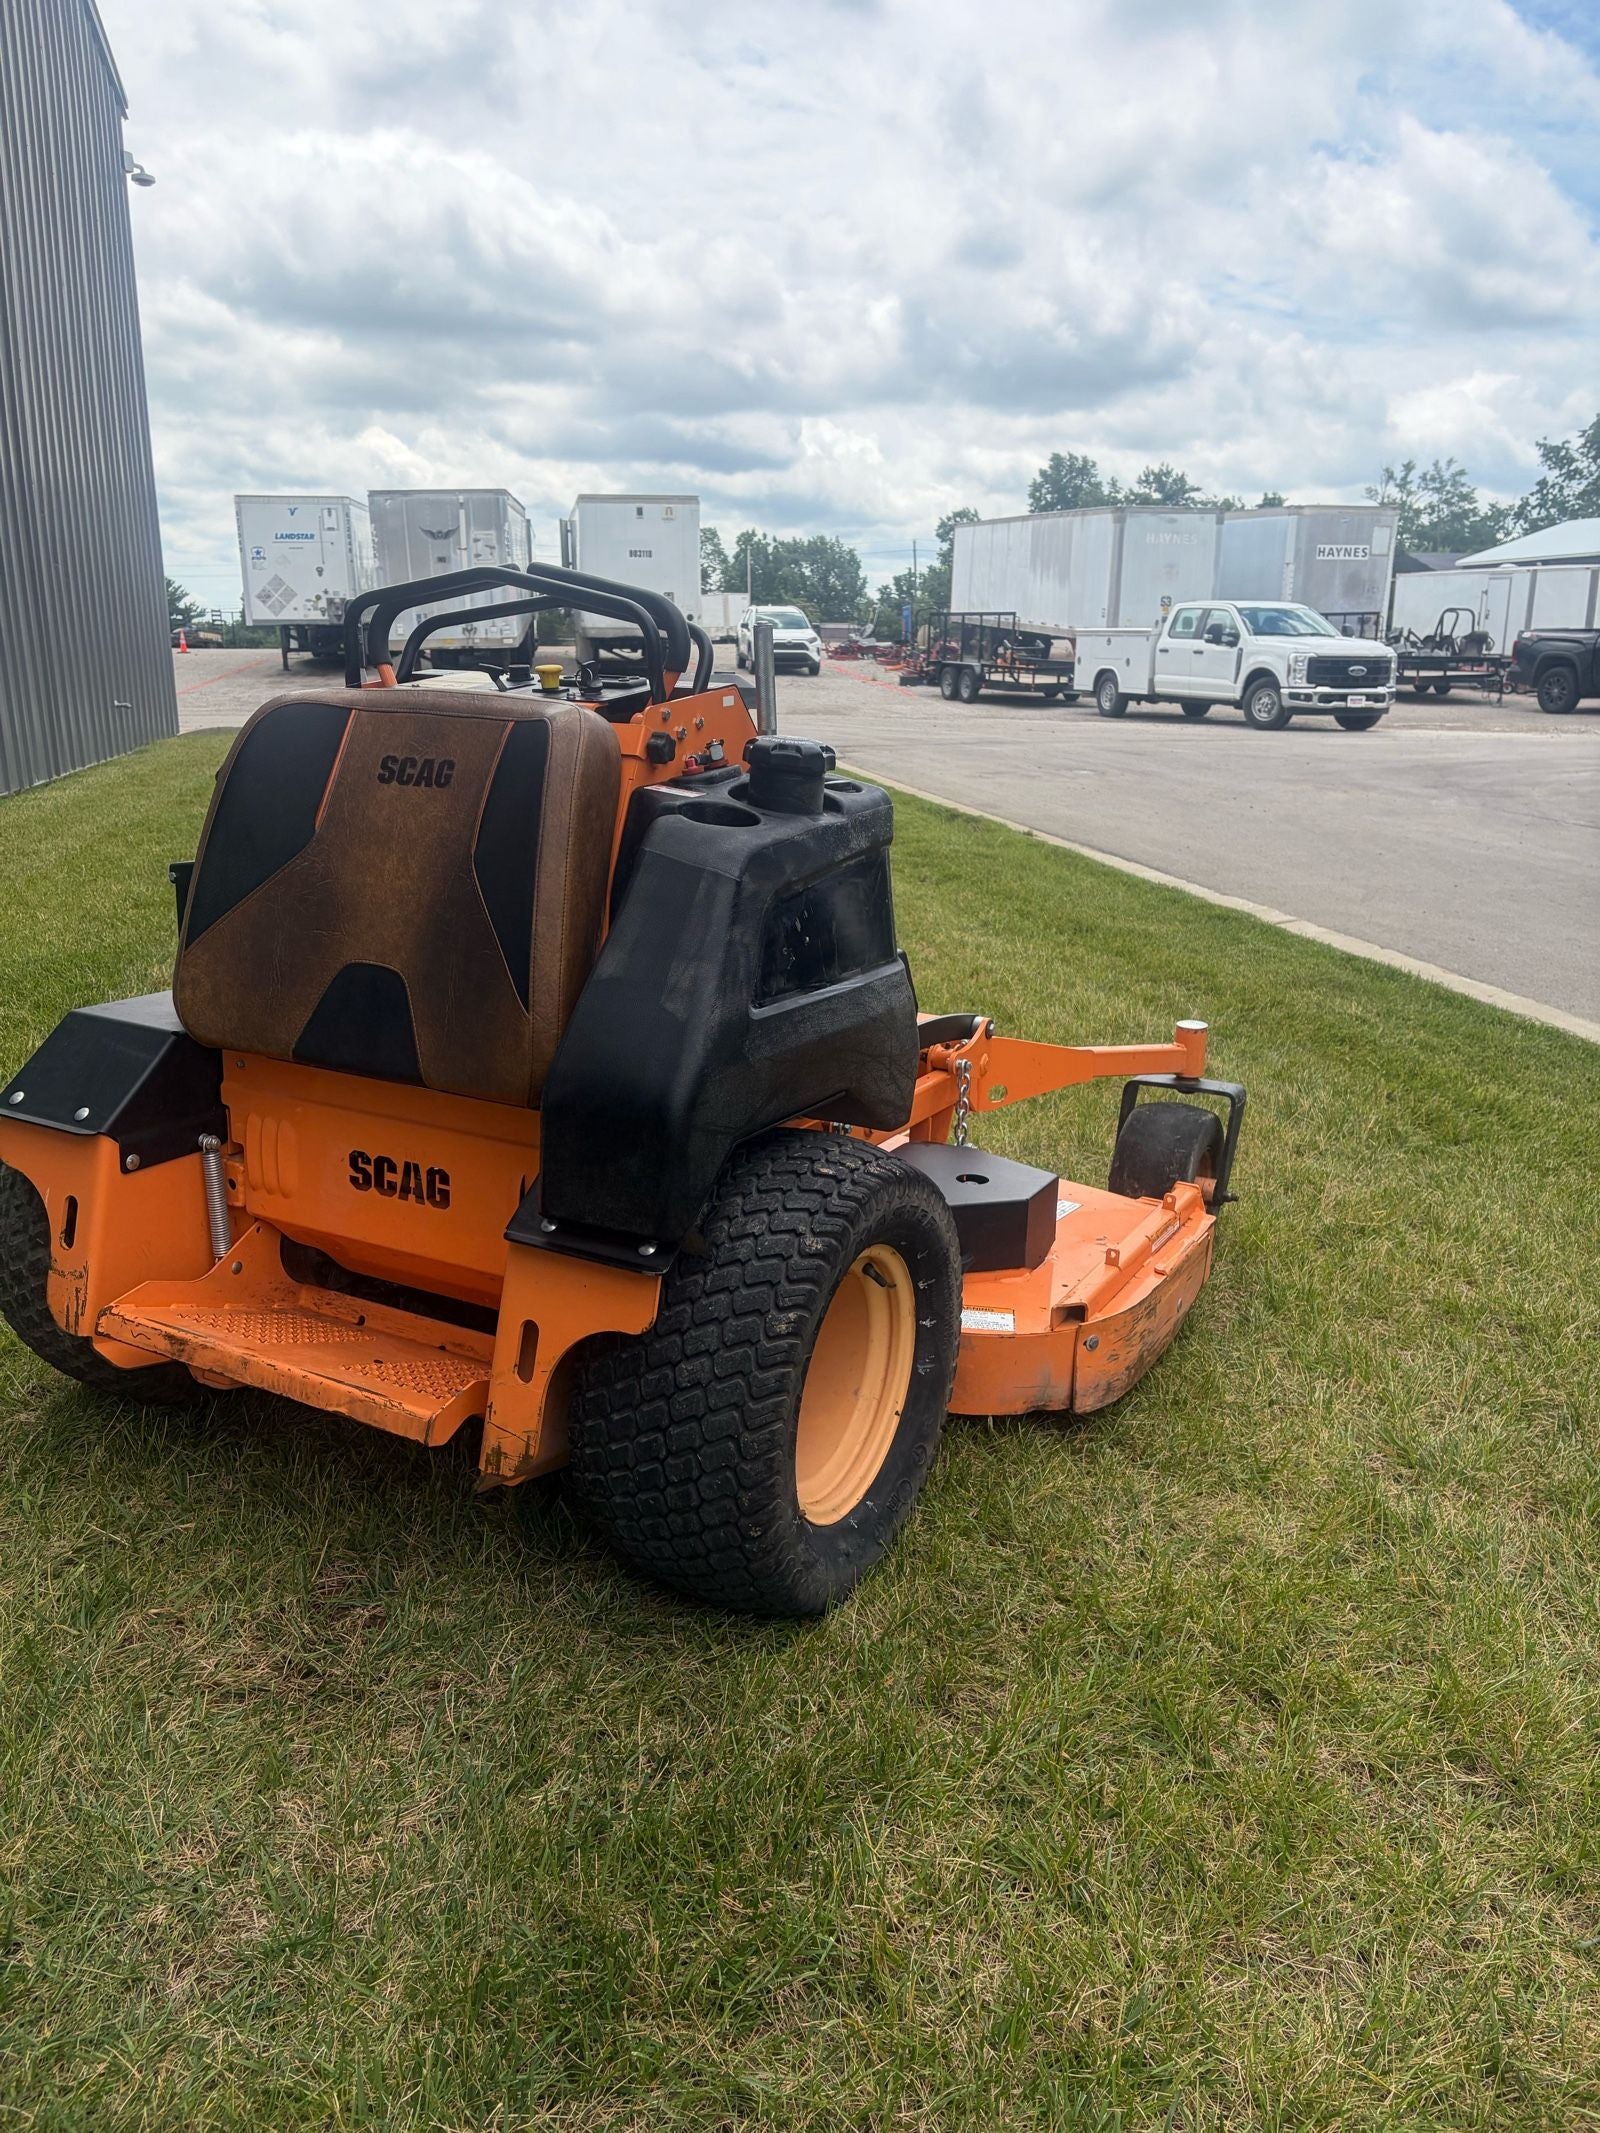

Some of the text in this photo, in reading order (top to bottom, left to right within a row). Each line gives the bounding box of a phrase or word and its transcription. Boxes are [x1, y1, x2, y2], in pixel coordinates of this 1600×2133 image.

[1146, 532, 1198, 545] HAYNES
[1317, 547, 1368, 558] HAYNES
[377, 755, 456, 788] SCAG
[348, 1149, 451, 1210] SCAG
